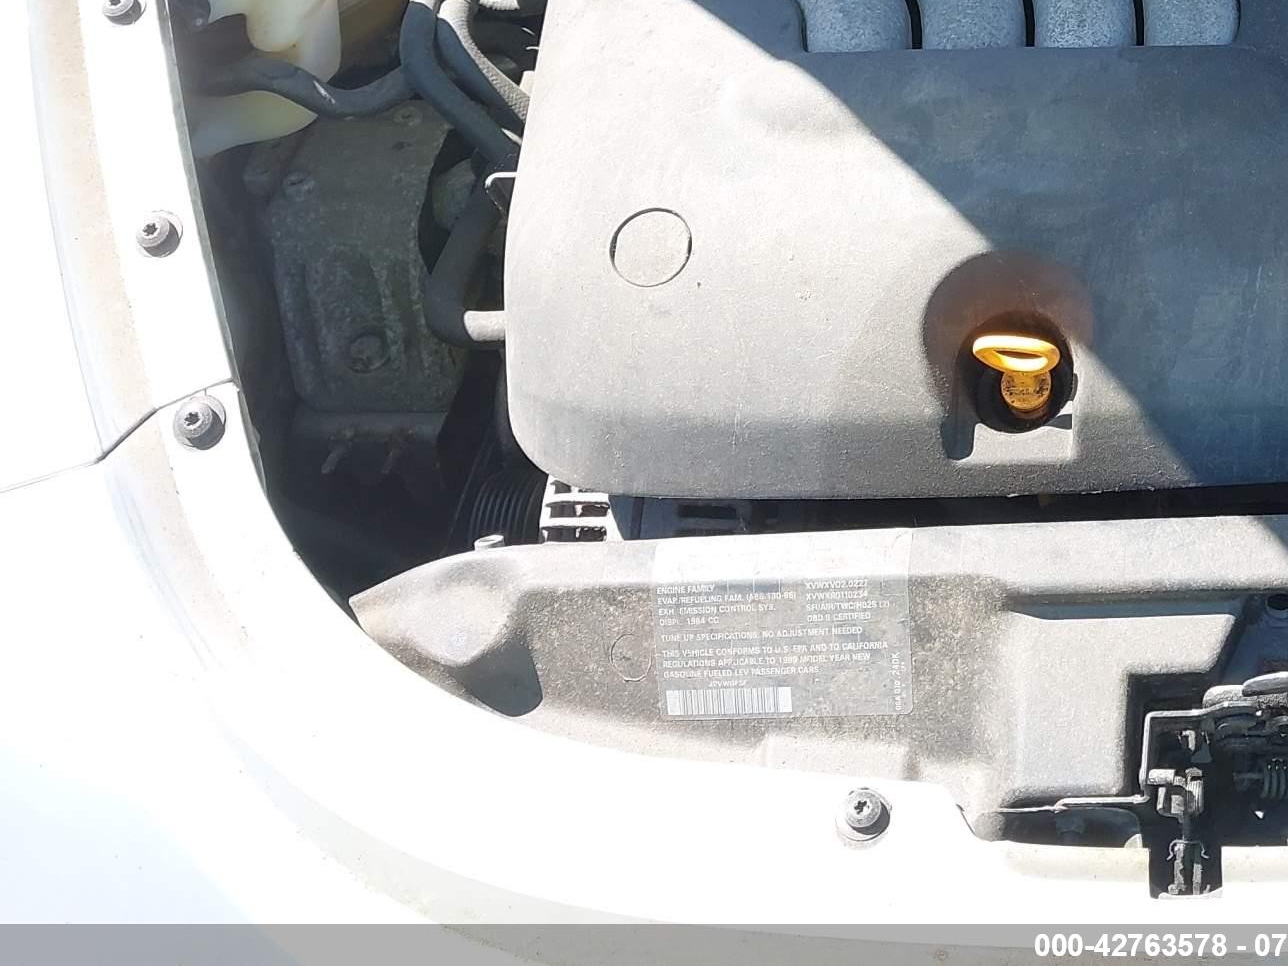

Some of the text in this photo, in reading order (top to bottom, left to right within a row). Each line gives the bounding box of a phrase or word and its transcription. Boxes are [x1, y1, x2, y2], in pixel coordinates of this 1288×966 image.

[657, 584, 715, 594] ENGINE FAMILY
[718, 604, 756, 612] CONTROL
[833, 612, 871, 621] CERTIFIED
[776, 628, 829, 638] ADJUSTMENT
[831, 626, 862, 634] NEEDED
[762, 646, 773, 654] TO
[810, 644, 827, 652] AND
[829, 643, 840, 651] TO
[842, 642, 888, 650] CALIFORNIA
[662, 660, 716, 668] REGULATIONS
[800, 654, 828, 663] MODEL
[830, 654, 850, 662] YEAR
[852, 652, 871, 661] NEW
[664, 670, 701, 679] GASOLINE
[704, 669, 732, 678] FUELED
[750, 667, 796, 676] PASSENGER
[798, 666, 820, 674] CARS
